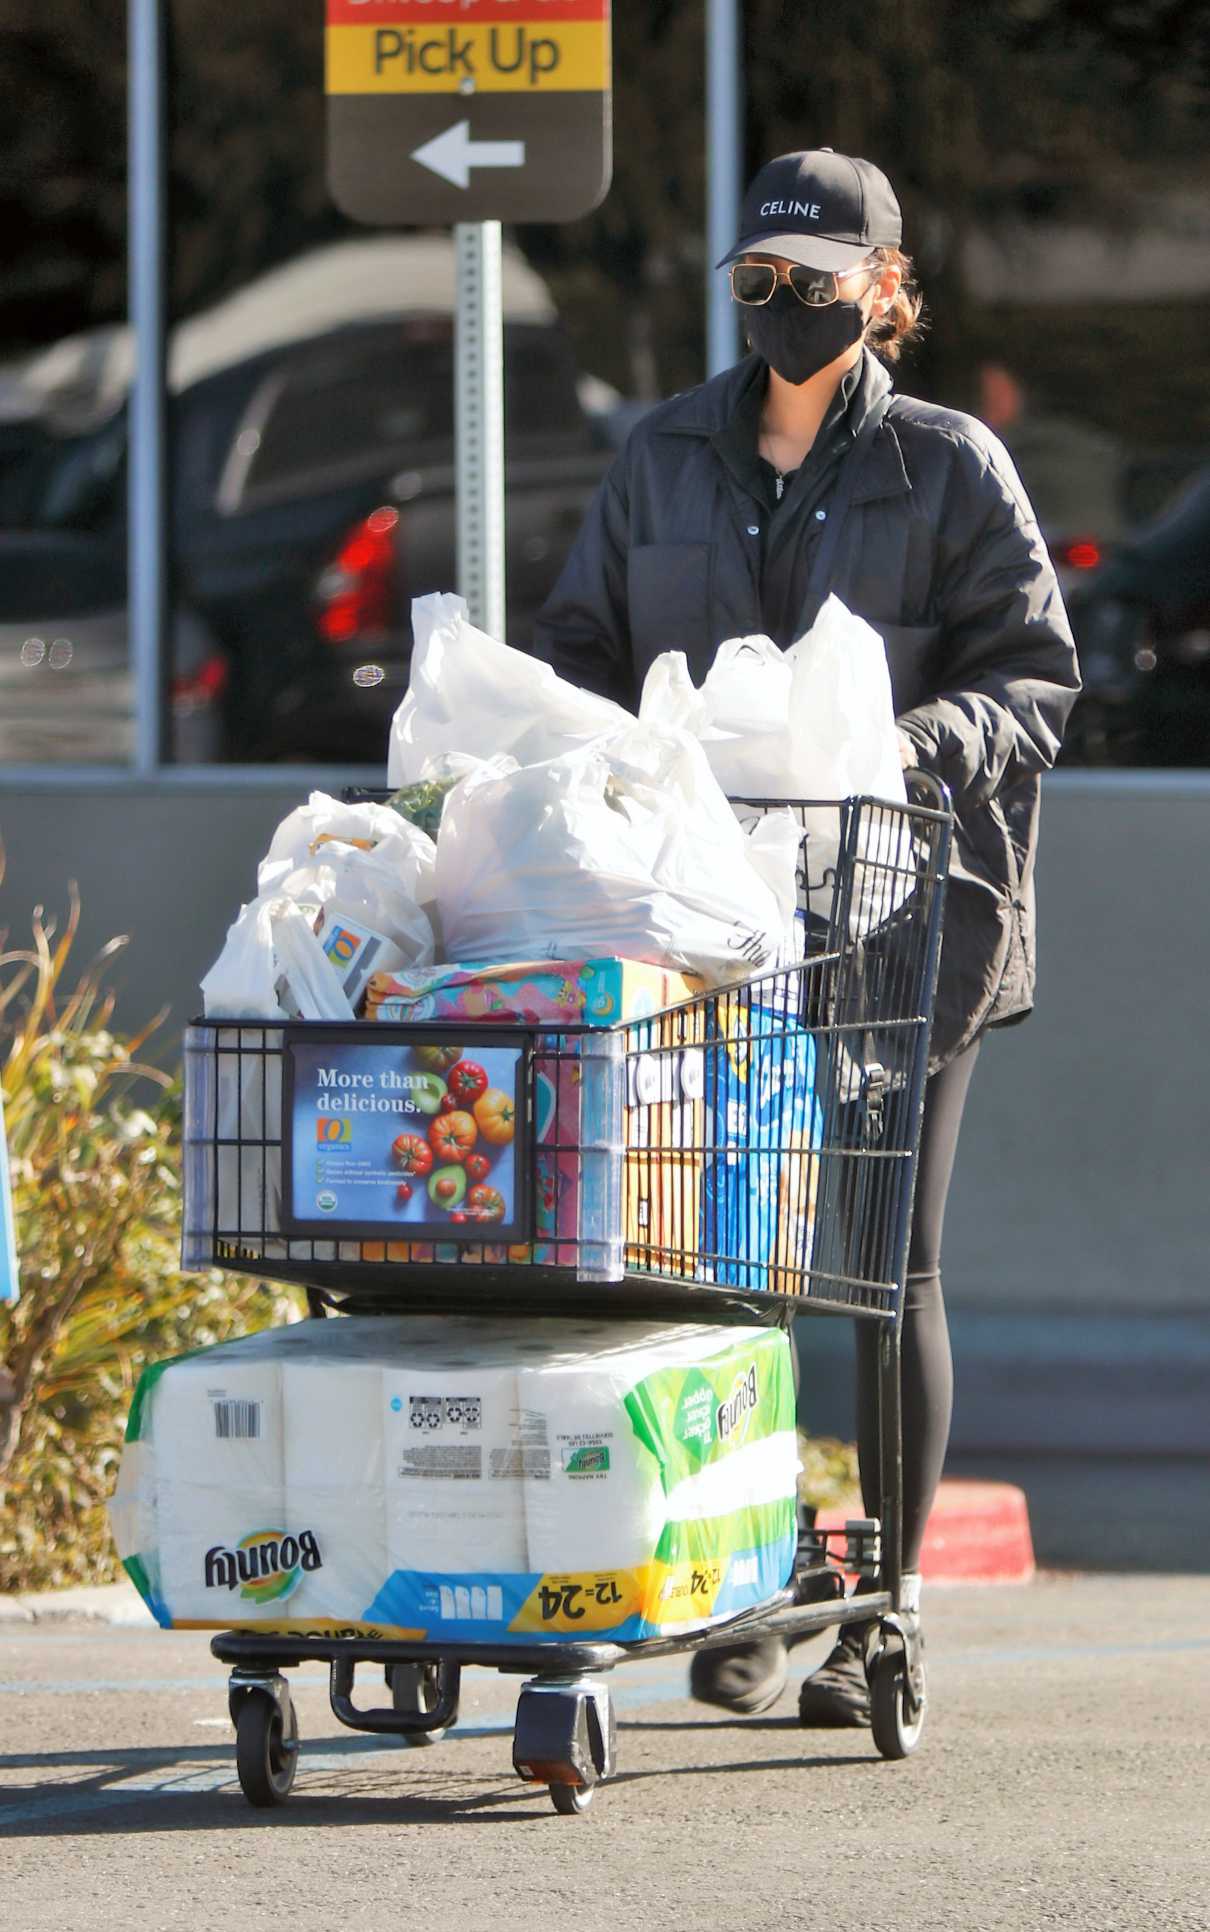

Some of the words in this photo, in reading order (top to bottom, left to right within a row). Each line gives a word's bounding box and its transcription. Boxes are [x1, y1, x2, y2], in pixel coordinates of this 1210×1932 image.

[374, 27, 476, 75] Pick
[490, 25, 560, 84] Up
[760, 200, 822, 220] CELINE
[316, 1068, 374, 1088] More
[380, 1069, 429, 1090] than
[316, 1092, 422, 1113] delicious.
[204, 1529, 323, 1591] Bounty
